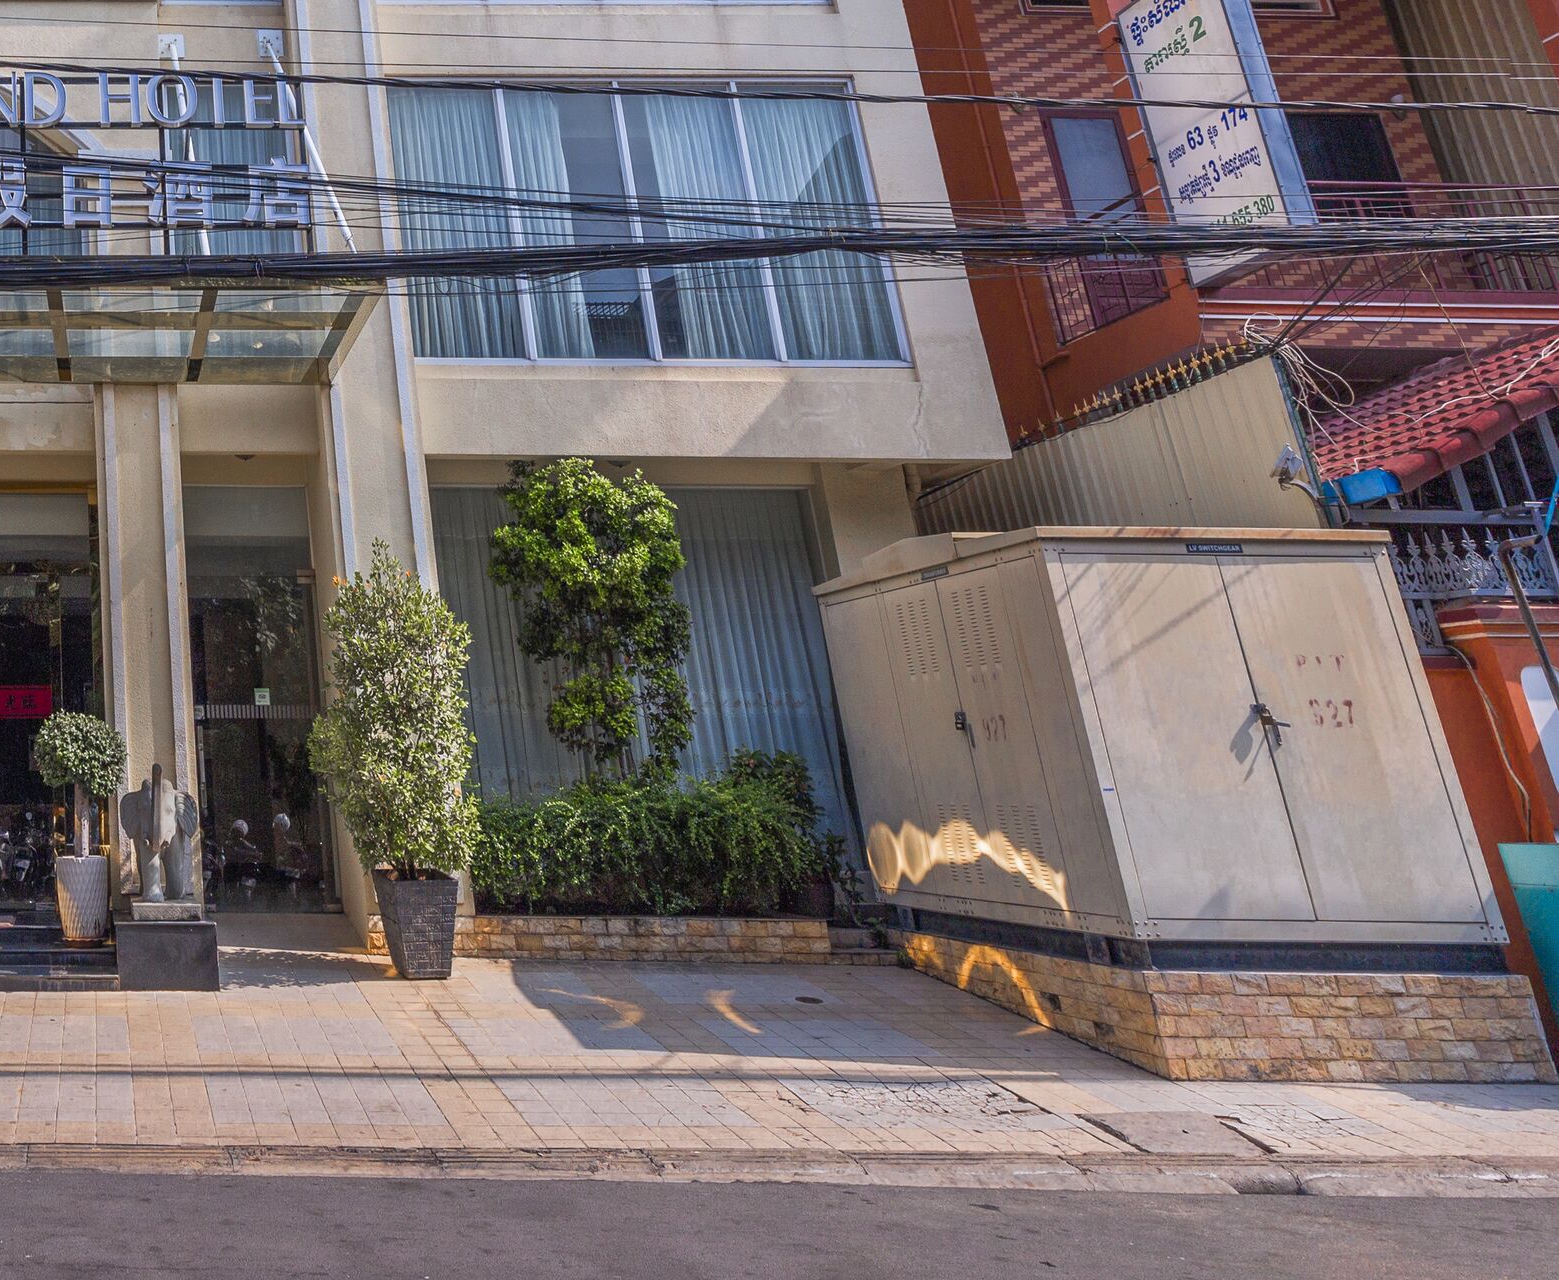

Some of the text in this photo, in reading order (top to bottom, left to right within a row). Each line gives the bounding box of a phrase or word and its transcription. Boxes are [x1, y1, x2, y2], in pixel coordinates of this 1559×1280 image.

[1188, 15, 1207, 42] 2
[98, 72, 306, 128] HOTEL
[1186, 126, 1204, 150] 63
[1221, 107, 1248, 132] 174
[1208, 159, 1221, 183] 3
[1253, 194, 1275, 218] 380
